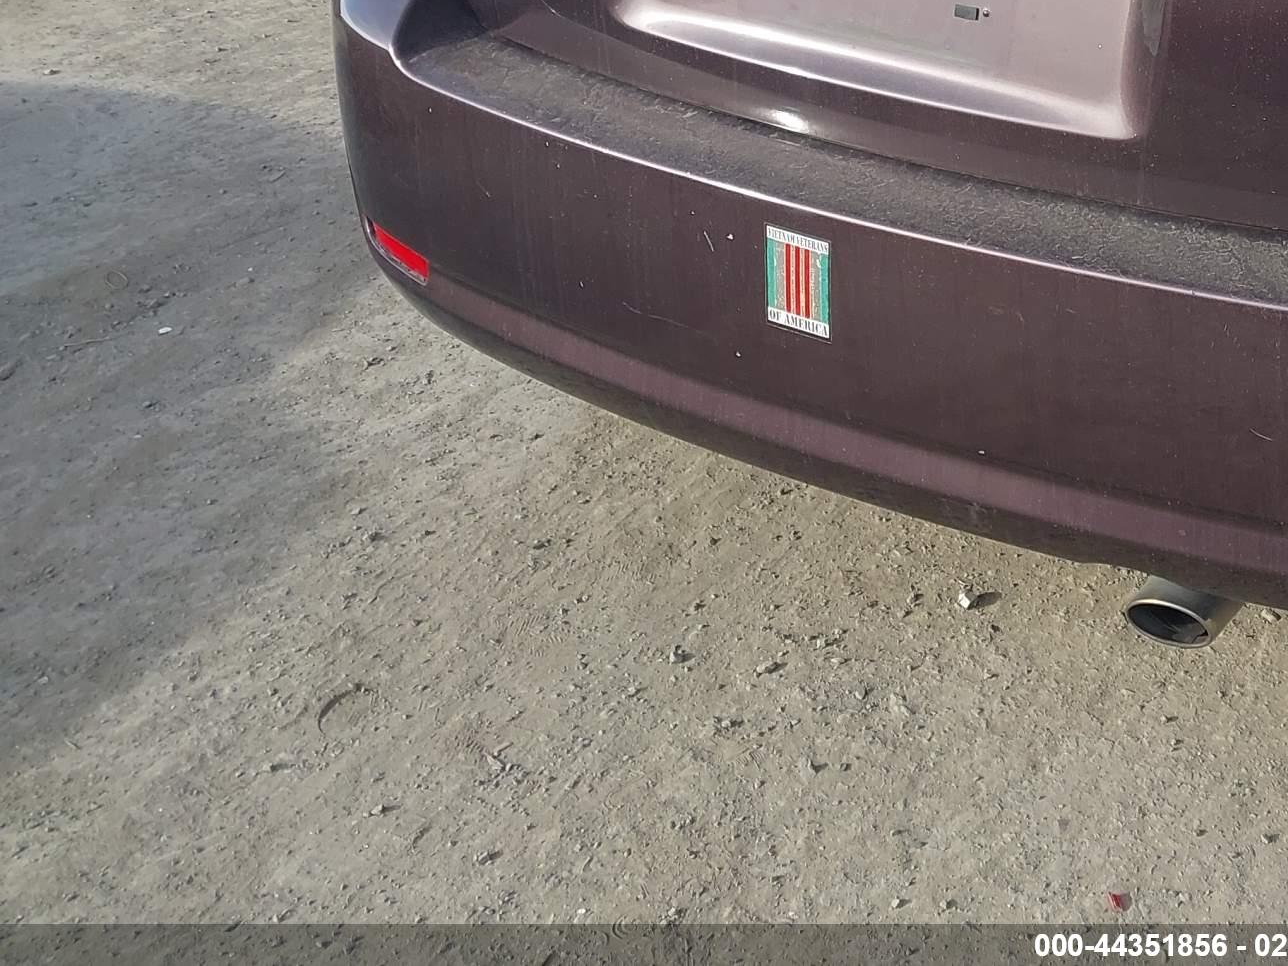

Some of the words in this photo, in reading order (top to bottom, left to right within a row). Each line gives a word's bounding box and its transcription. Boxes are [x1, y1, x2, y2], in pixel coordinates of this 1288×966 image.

[768, 227, 795, 244] VIETNAM
[796, 234, 829, 252] VETERANS
[769, 309, 782, 321] OF
[785, 313, 829, 336] AMERICA
